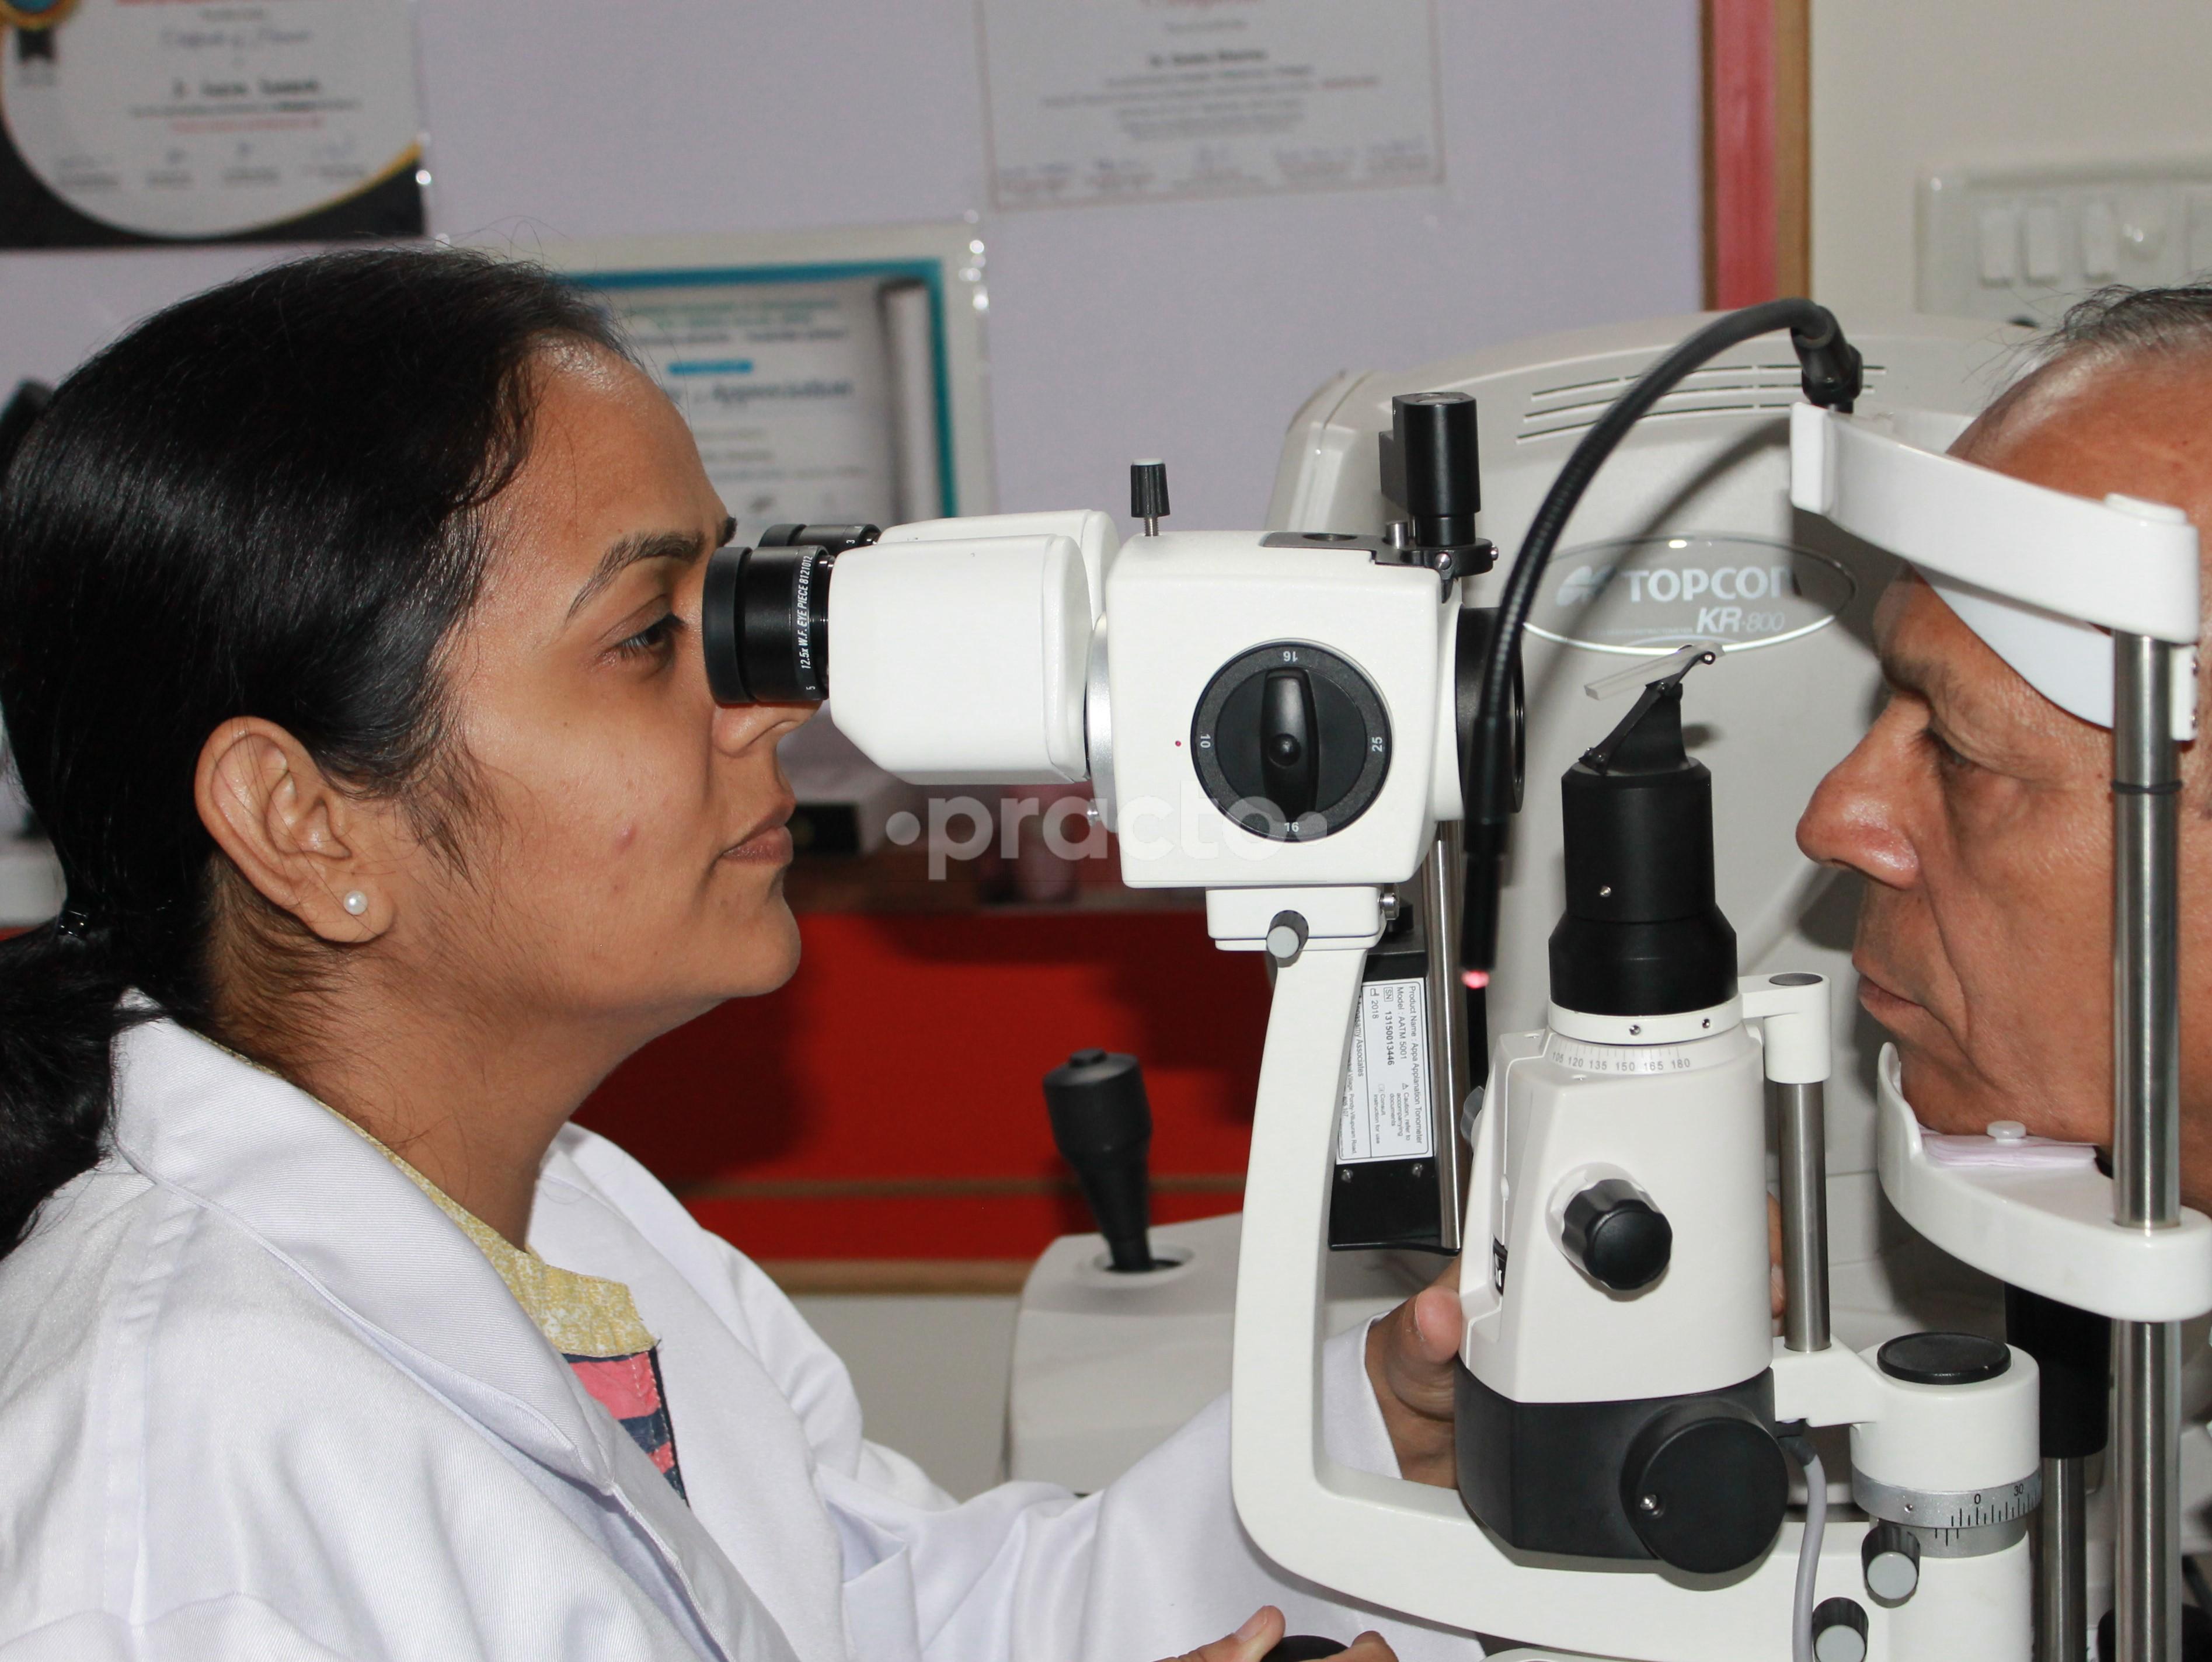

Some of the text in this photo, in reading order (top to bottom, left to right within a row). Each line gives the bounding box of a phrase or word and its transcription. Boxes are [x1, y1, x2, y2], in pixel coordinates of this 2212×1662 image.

[799, 555, 813, 584] 8121012
[797, 584, 808, 609] PIECE
[797, 610, 807, 627] EYE
[797, 629, 808, 646] W.F.
[799, 647, 811, 669] 12.5x
[1200, 733, 1211, 748] 10
[1371, 736, 1383, 752] 25
[1284, 821, 1300, 832] 16
[1385, 1011, 1395, 1065] 13150013446
[1356, 1039, 1365, 1077] Associates
[1410, 1042, 1419, 1061] Appa
[1552, 1051, 1691, 1071] 105 120 135 150 165 180
[1411, 1062, 1421, 1105] Applanation
[1974, 1483, 2024, 1504] 0 30
